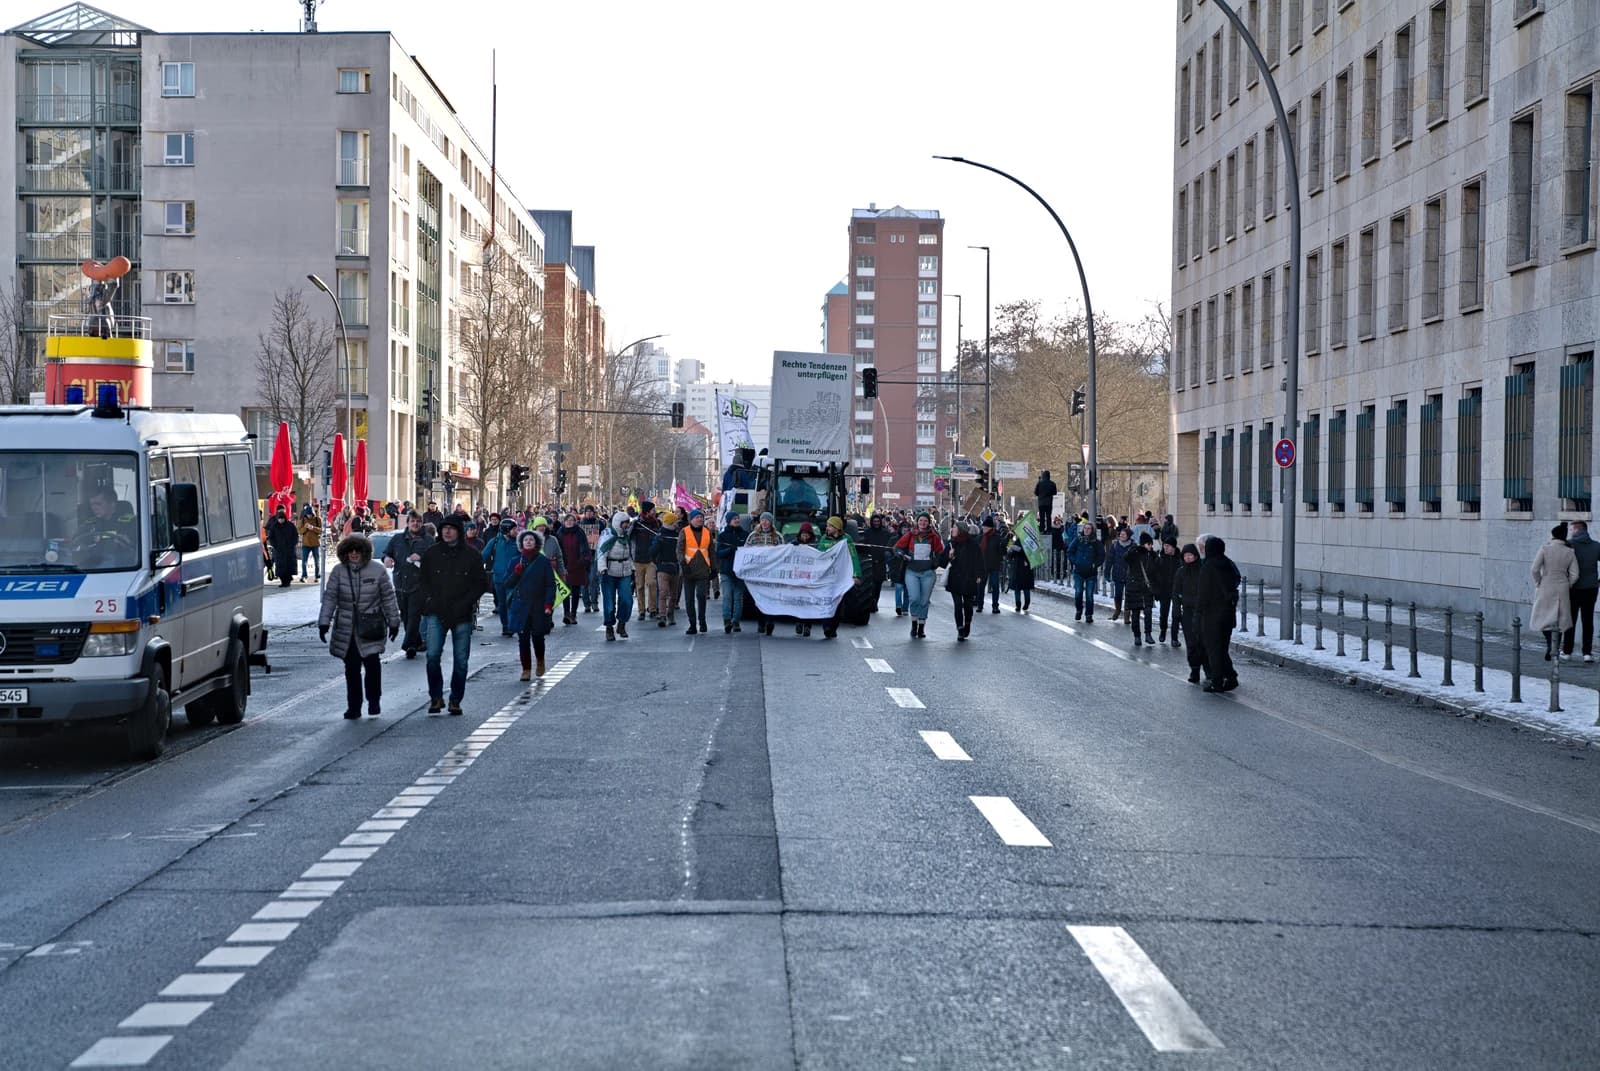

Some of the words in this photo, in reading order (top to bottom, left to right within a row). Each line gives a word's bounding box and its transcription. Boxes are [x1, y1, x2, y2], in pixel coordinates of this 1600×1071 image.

[782, 360, 807, 369] Rechte
[809, 361, 847, 371] Tendenzen
[797, 371, 847, 381] unterpflügen!
[0, 690, 22, 702] 545
